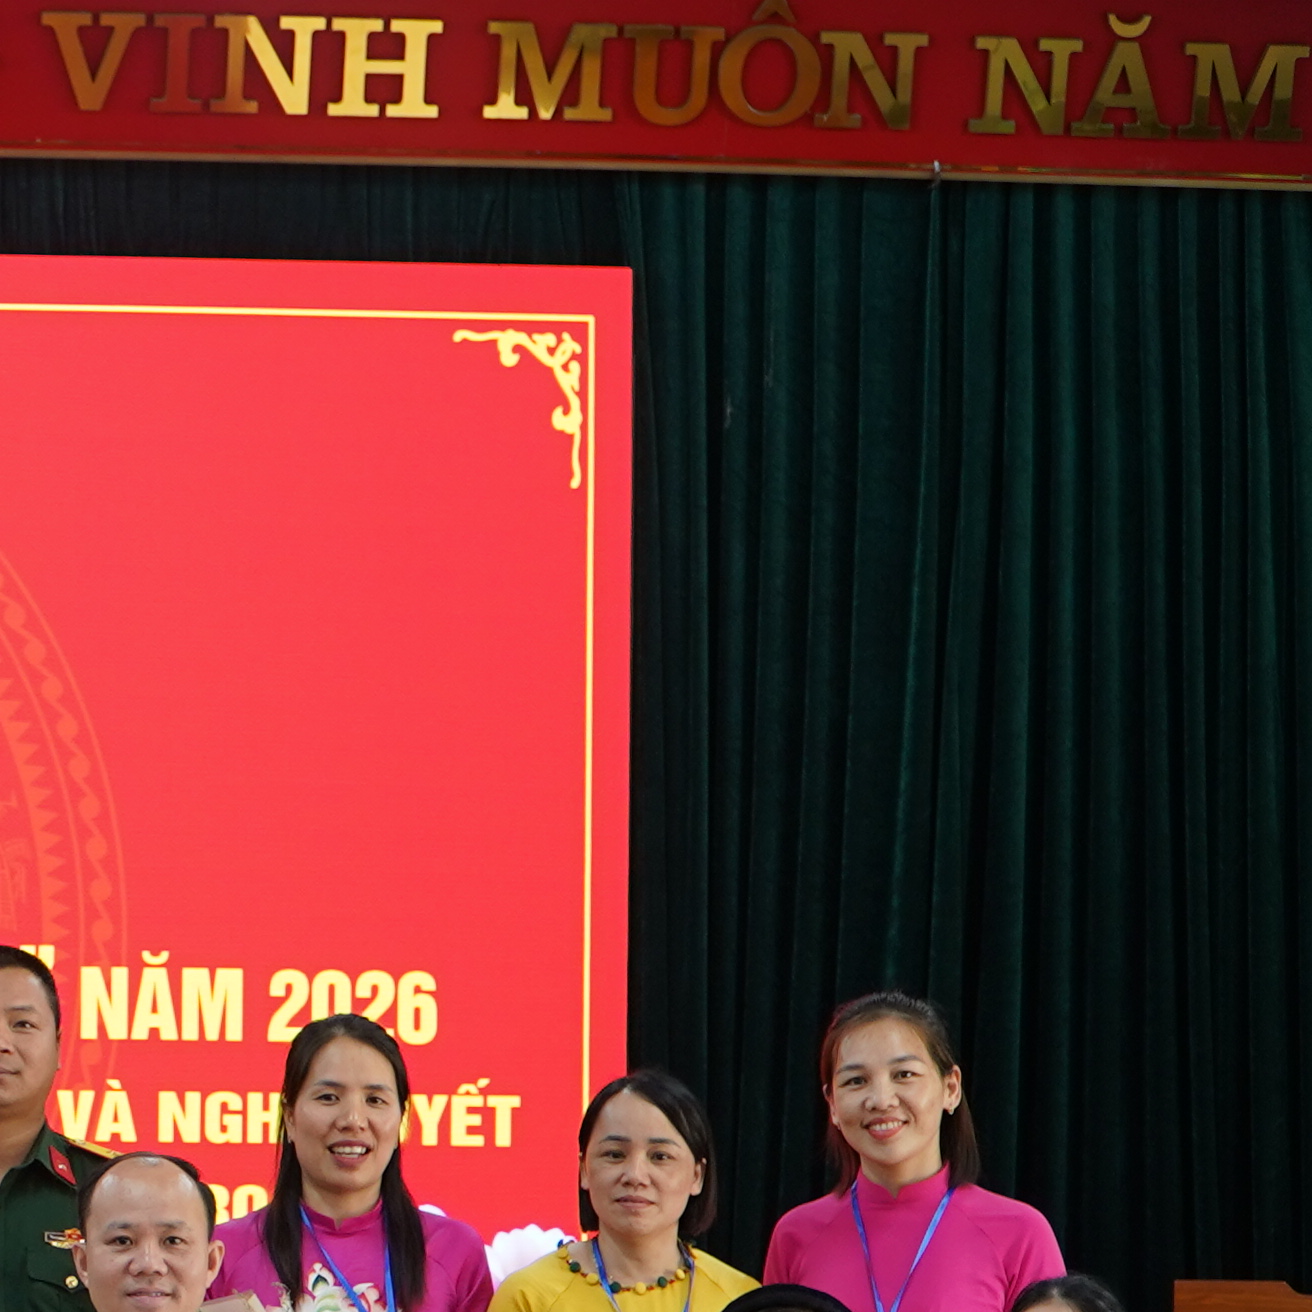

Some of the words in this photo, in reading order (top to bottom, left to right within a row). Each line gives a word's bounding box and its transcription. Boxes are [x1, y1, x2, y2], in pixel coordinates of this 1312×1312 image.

[40, 11, 443, 118] VINH
[482, 0, 929, 130] MUÔN
[967, 12, 1310, 141] NĂM
[80, 950, 244, 1042] NĂM
[267, 969, 438, 1046] 2026
[57, 1079, 138, 1143] VÀ
[158, 1091, 283, 1144] NGH
